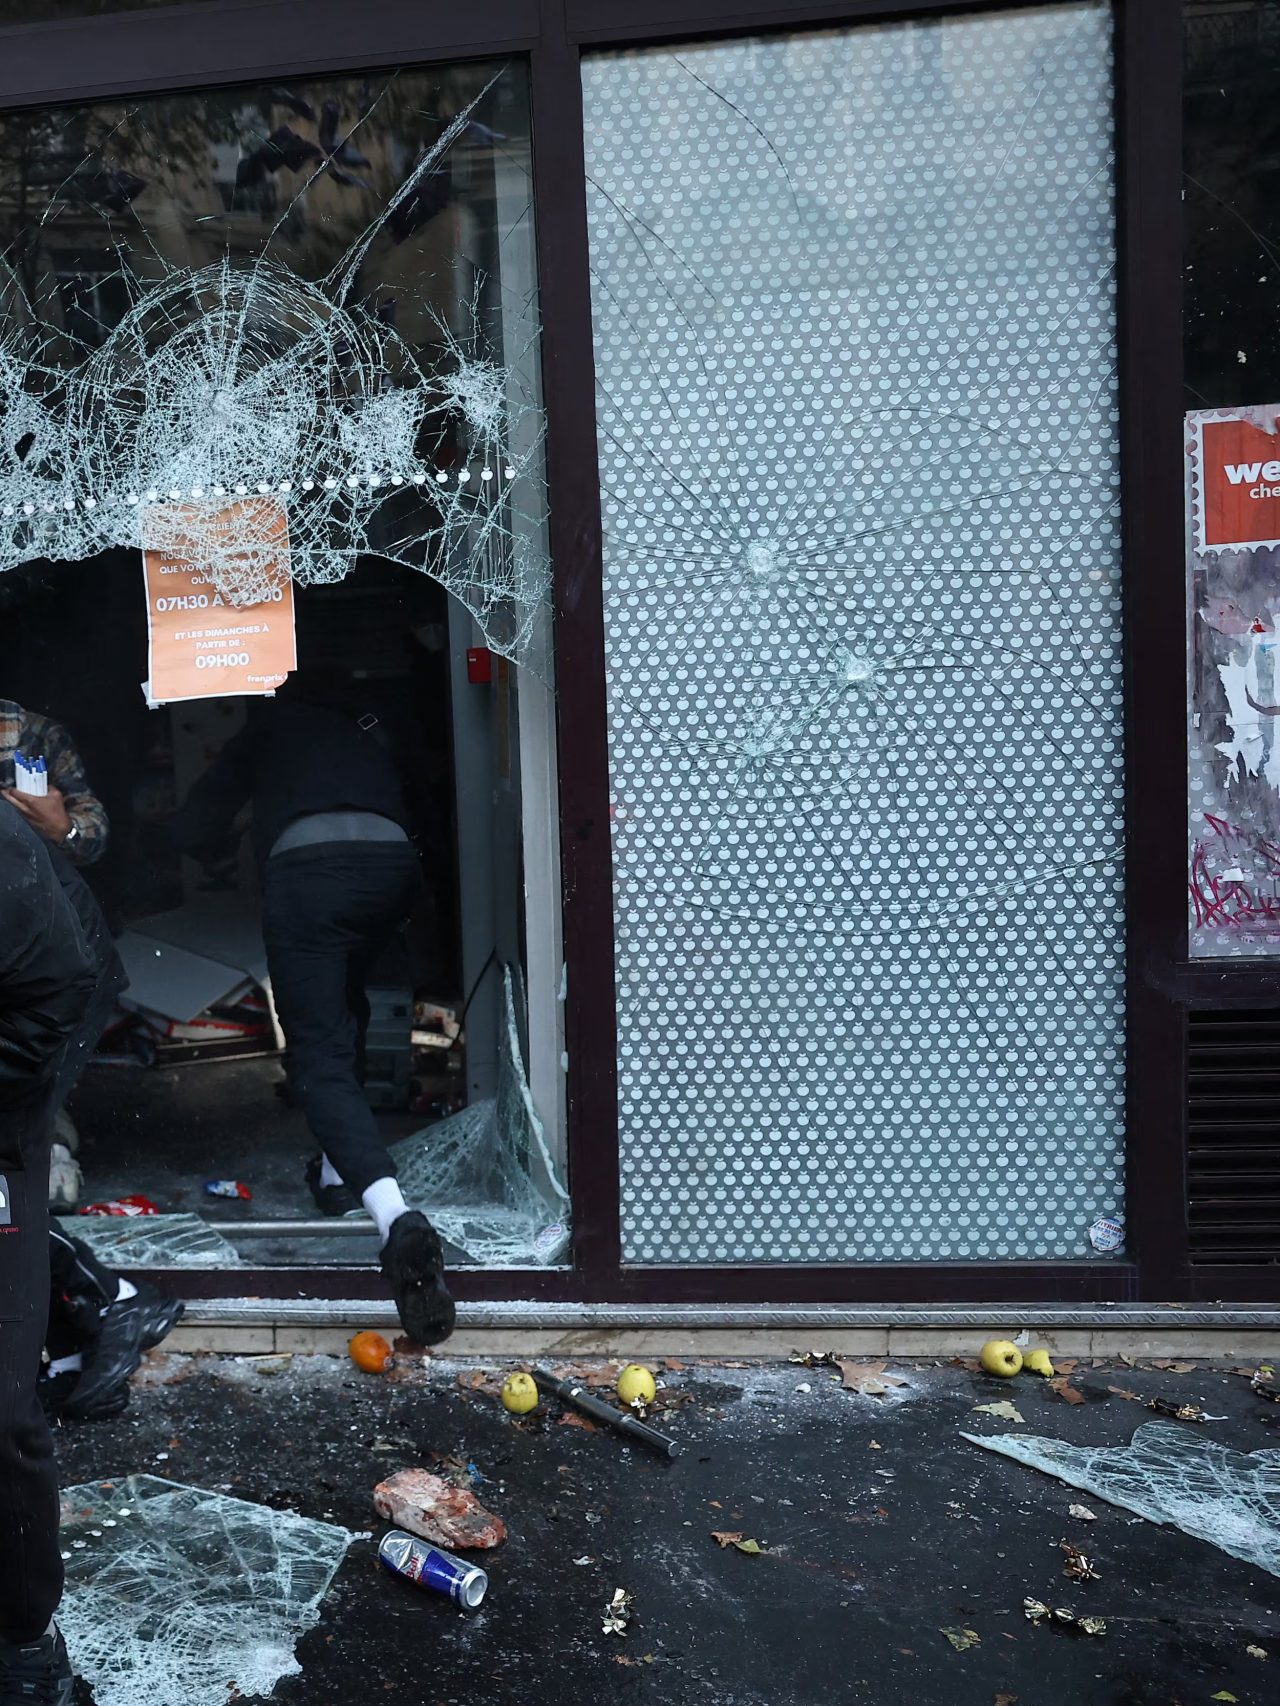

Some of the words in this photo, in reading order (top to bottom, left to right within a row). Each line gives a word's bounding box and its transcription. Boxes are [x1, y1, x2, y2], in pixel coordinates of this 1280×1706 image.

[159, 565, 178, 575] QUE
[155, 595, 209, 612] 07H30
[174, 632, 186, 641] ET
[187, 629, 204, 639] LES
[204, 624, 260, 637] DIMANCHES
[195, 640, 227, 650] PARTIR
[228, 639, 240, 648] DE
[195, 652, 250, 670] 09H00
[247, 673, 283, 684] franprix
